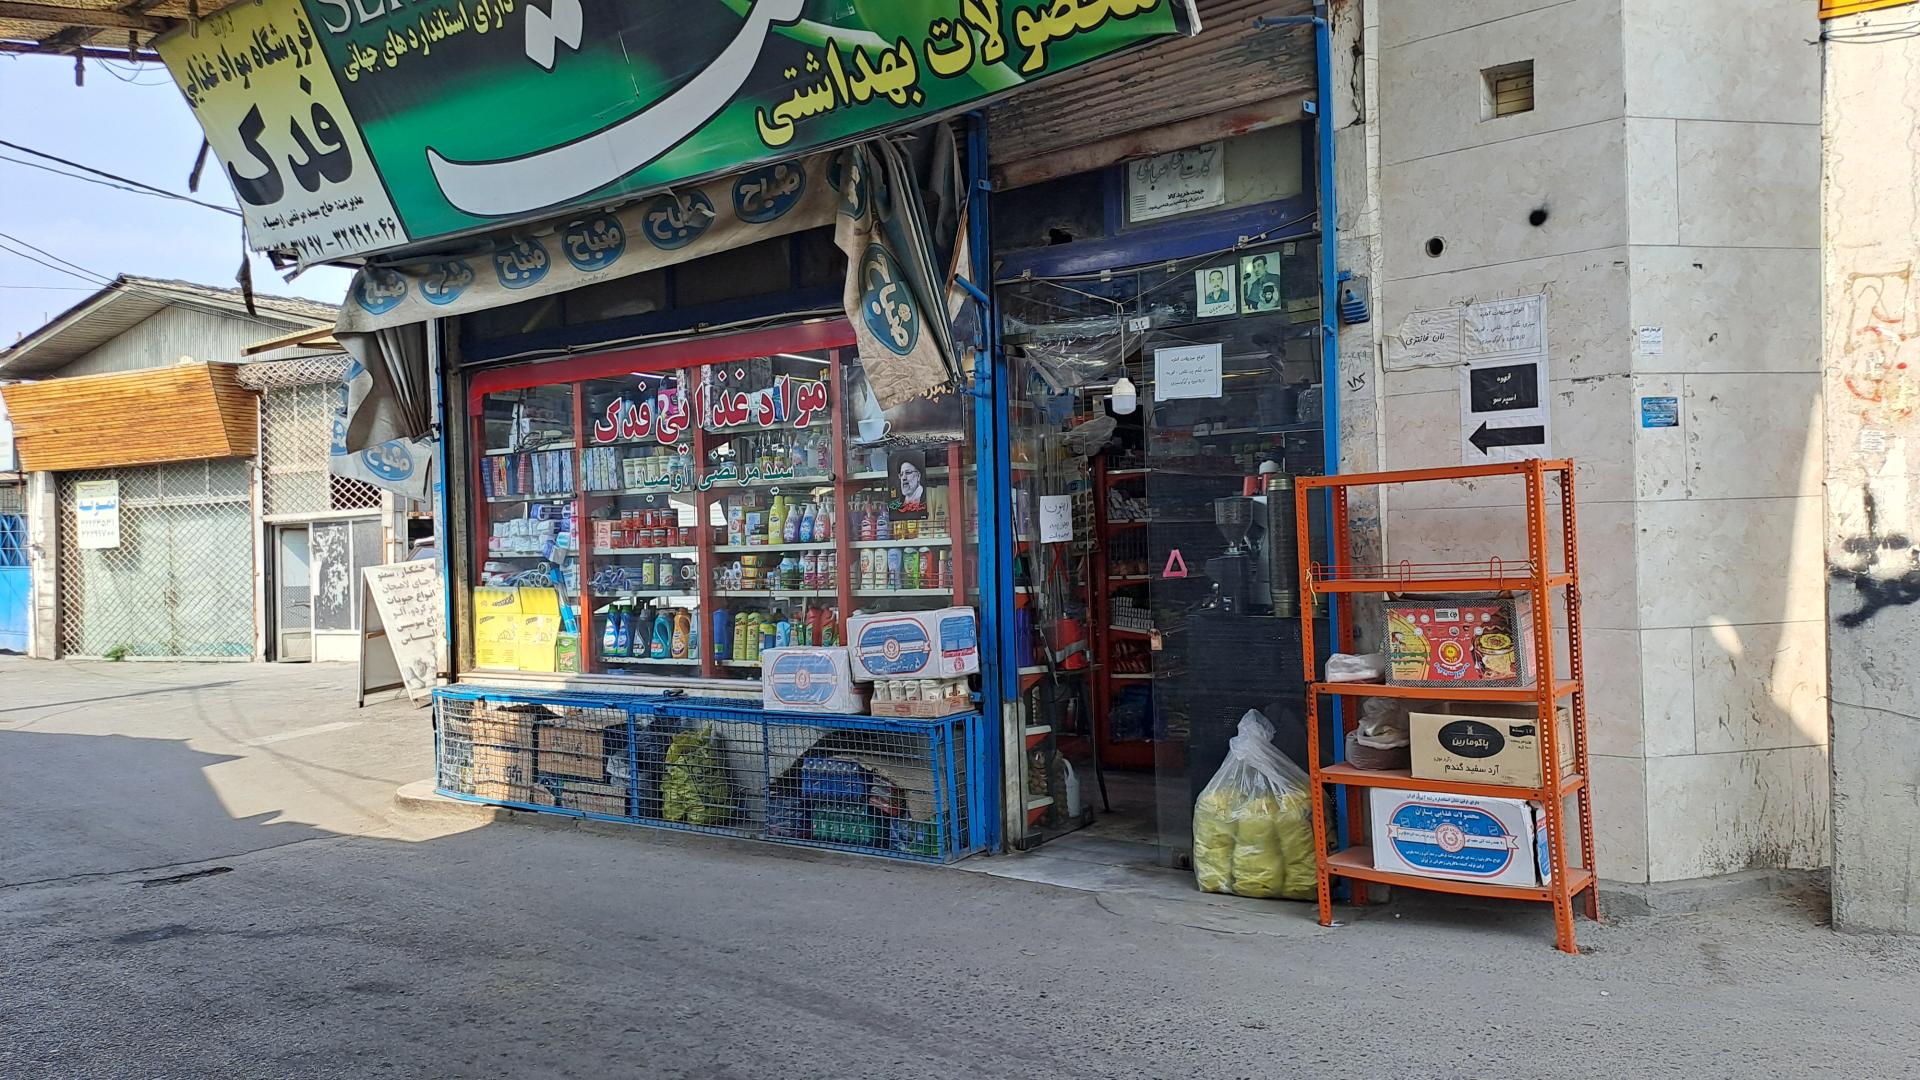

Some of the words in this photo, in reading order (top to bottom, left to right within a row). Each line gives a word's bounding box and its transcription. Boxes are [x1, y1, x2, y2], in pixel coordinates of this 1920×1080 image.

[249, 7, 314, 69] فروشگاه
[409, 1, 471, 56] استاندارد
[216, 43, 253, 90] مواد
[344, 39, 381, 82] جهانی
[382, 29, 407, 68] های
[756, 39, 924, 147] بهداشتی
[228, 74, 354, 207] فدک
[319, 201, 334, 218] حاج
[1405, 333, 1430, 346] فانتزی
[1432, 332, 1445, 343] نان
[1496, 372, 1512, 384] قهوه
[593, 381, 652, 444] فدک
[655, 367, 751, 456] غذایی
[756, 373, 828, 429] مواد
[1492, 393, 1517, 405] اسپرسو
[635, 462, 690, 503] اوصیاء
[699, 449, 761, 492] مرتضی
[761, 459, 796, 496] سید
[386, 594, 414, 605] حبوبات
[416, 589, 436, 603] انواع
[1451, 736, 1489, 751] پاکومارین
[1444, 762, 1464, 774] گندم
[1465, 764, 1487, 775] سفید
[1488, 764, 1500, 775] آرد
